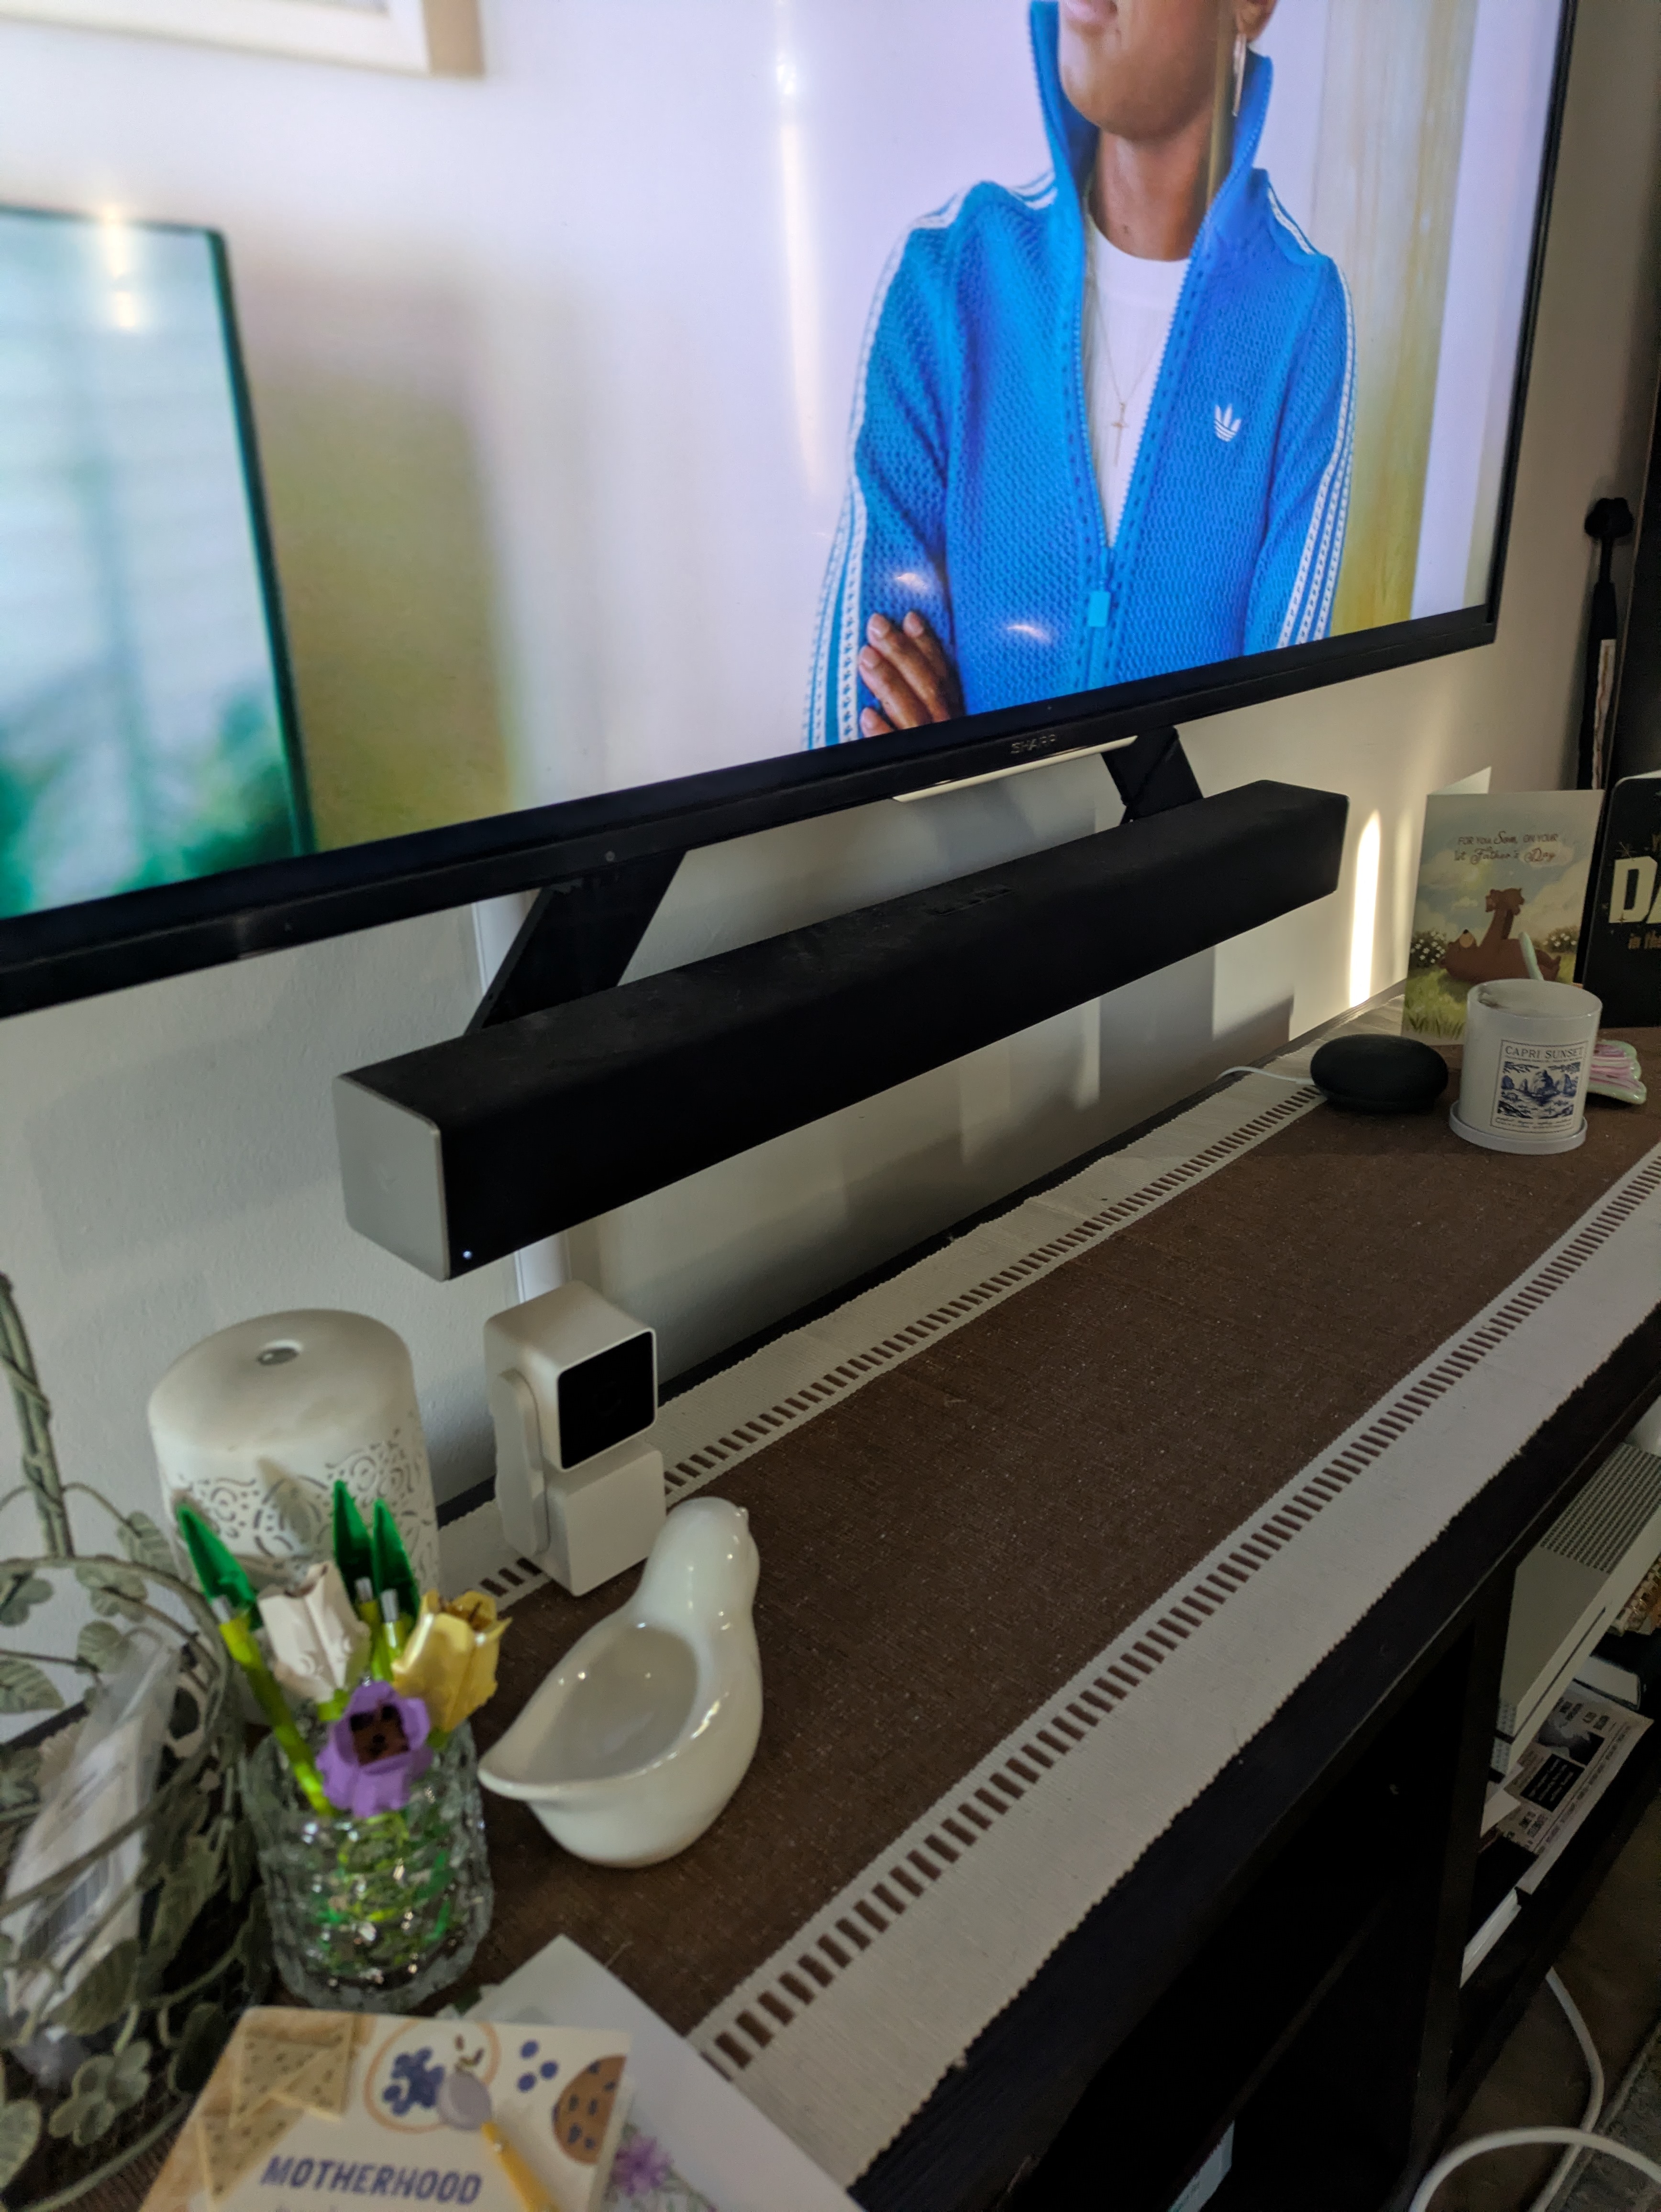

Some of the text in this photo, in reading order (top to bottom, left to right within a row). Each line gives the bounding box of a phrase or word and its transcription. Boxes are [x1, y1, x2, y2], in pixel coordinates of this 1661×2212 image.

[1010, 734, 1055, 754] SHARP
[1524, 848, 1557, 863] Day
[1505, 1045, 1540, 1059] CAPRI
[1546, 1046, 1584, 1059] SUNSET
[260, 2156, 482, 2205] MOTHERHOOD
